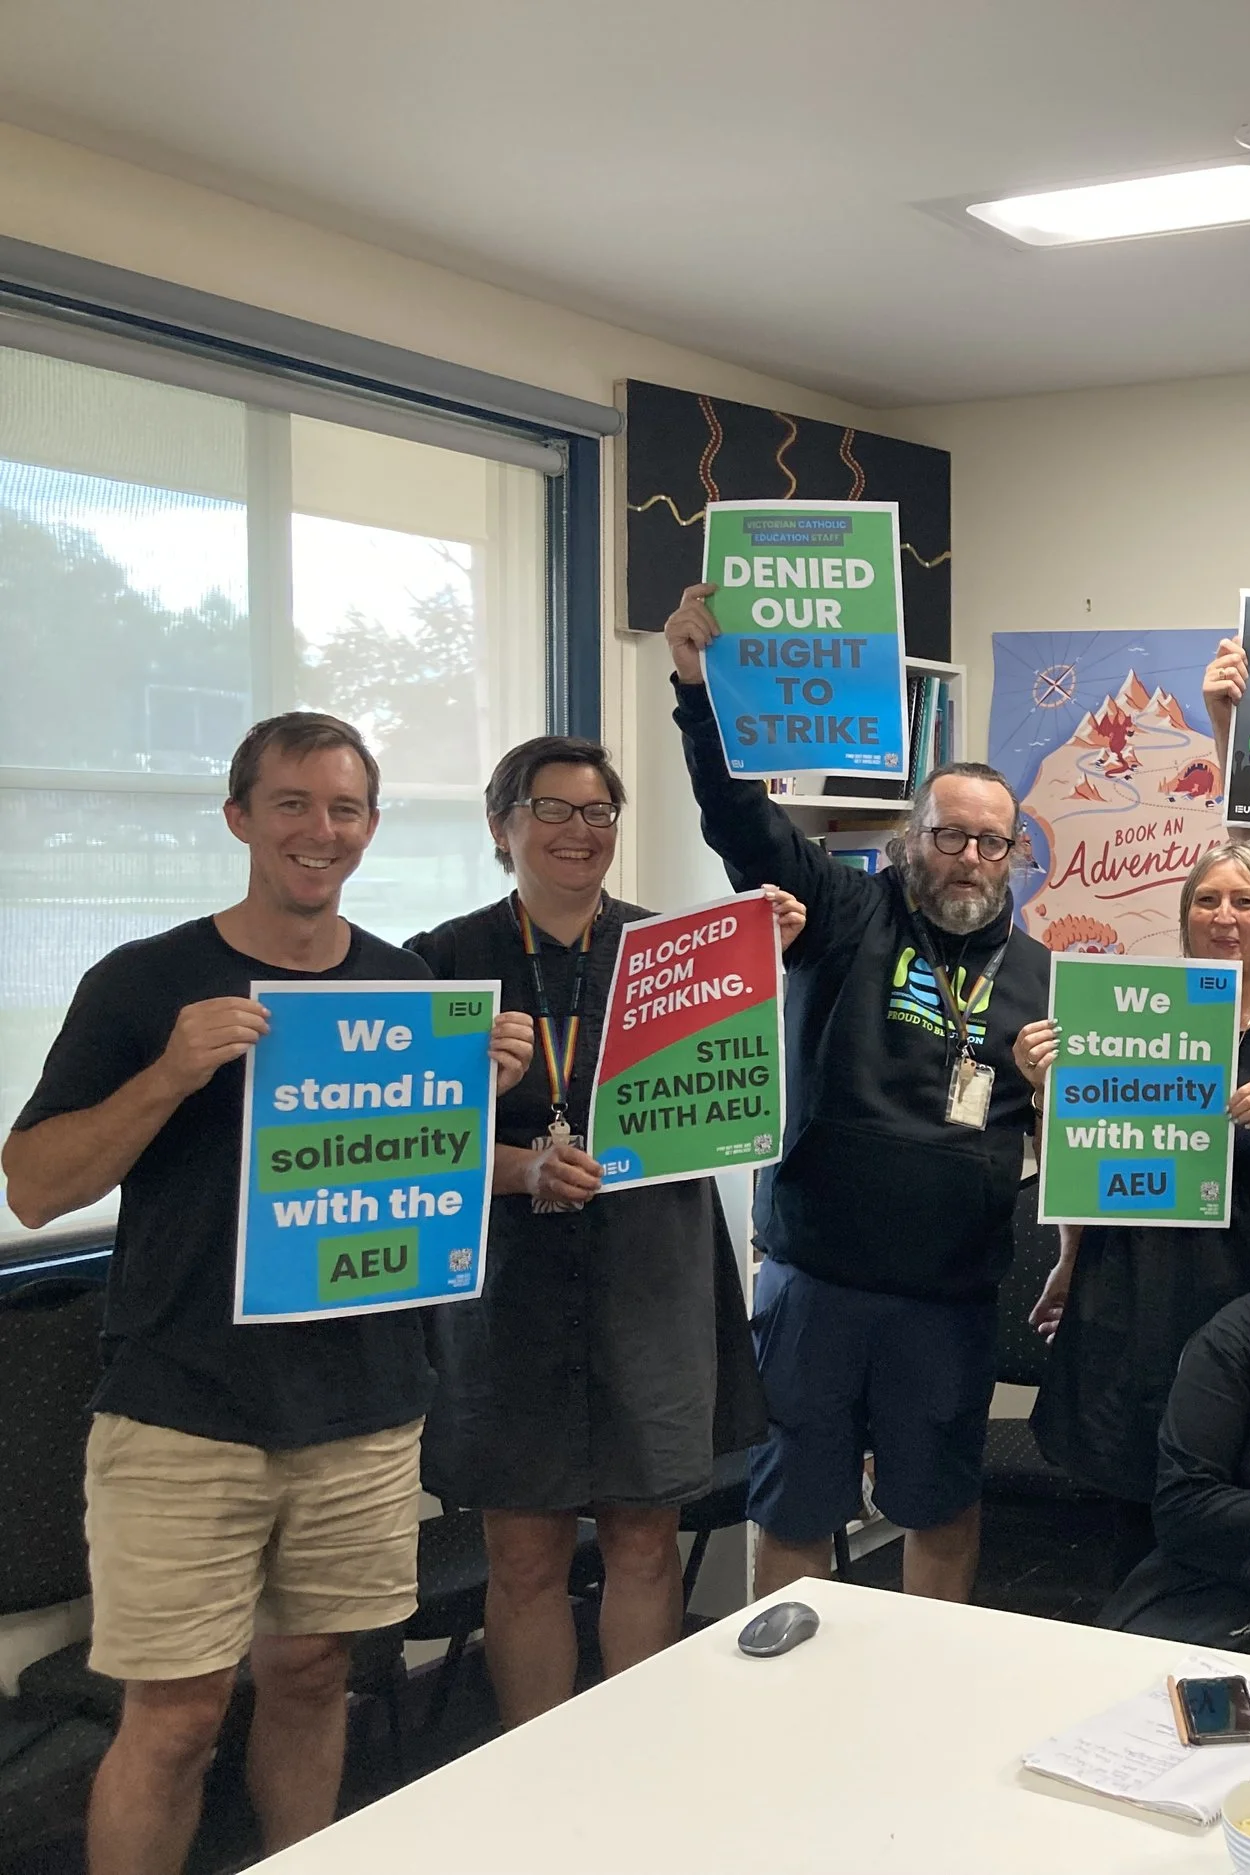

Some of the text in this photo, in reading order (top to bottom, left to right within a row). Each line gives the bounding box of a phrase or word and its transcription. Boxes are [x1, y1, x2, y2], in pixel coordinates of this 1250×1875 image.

[746, 519, 847, 529] VICTORIAN CATHOLIC
[754, 532, 840, 542] EDUCATION STAFF
[723, 556, 875, 589] DENIED
[751, 597, 843, 629] OUR
[739, 638, 867, 668] RIGHT
[776, 677, 833, 705] TO
[735, 714, 880, 746] STRIKE
[1235, 805, 1250, 814] IEU
[1115, 816, 1184, 846] BOOK AN
[628, 916, 738, 976] BLOCKED
[626, 958, 695, 1004] FROM
[1200, 976, 1227, 990] IEU
[449, 1001, 482, 1017] IEU
[622, 974, 753, 1031] STRIKING.
[1113, 986, 1171, 1015] We
[337, 1020, 413, 1052] We
[887, 1010, 920, 1025] PROUD
[921, 1019, 933, 1031] TO
[697, 1036, 769, 1063] STILL
[1067, 1032, 1211, 1061] stand in
[273, 1071, 463, 1111] stand in
[617, 1065, 770, 1105] STANDING
[1064, 1077, 1217, 1109] solidarity
[619, 1096, 771, 1136] WITH AEU.
[271, 1126, 471, 1174] solidarity
[1066, 1119, 1211, 1152] with the
[602, 1160, 630, 1176] IEU
[1106, 1172, 1168, 1197] AEU
[272, 1186, 463, 1228] with the
[330, 1245, 408, 1283] AEU
